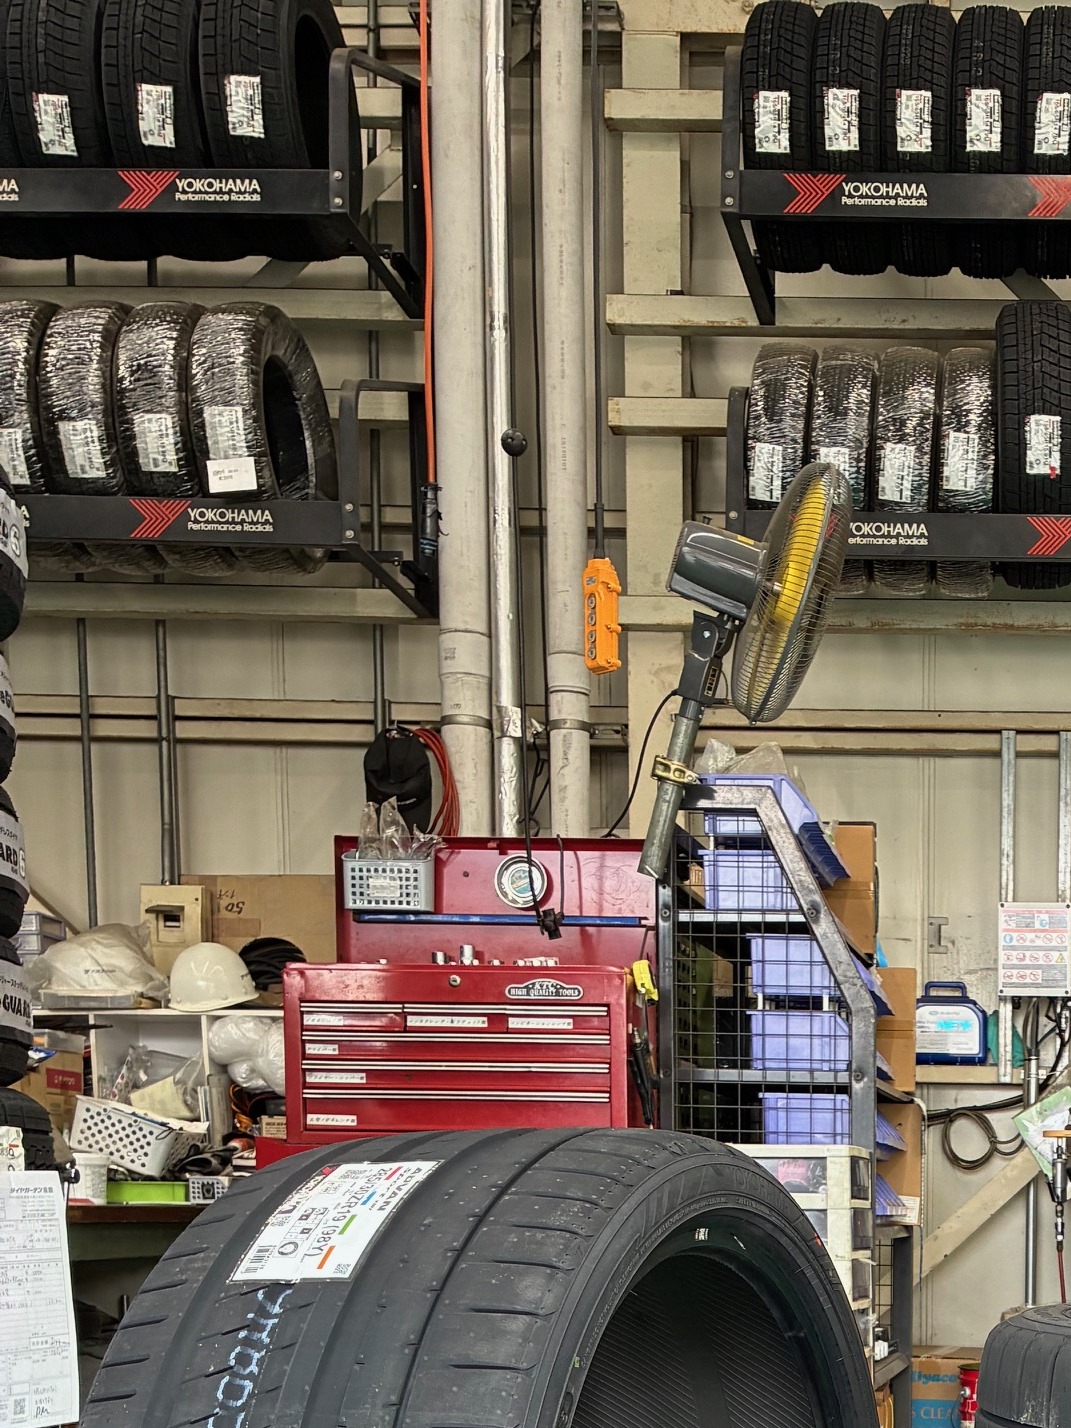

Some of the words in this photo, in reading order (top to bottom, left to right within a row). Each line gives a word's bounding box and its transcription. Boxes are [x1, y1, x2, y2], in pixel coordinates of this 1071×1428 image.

[176, 179, 260, 192] YOKOHAMA
[842, 182, 927, 196] YOKOHAMA
[175, 193, 228, 201] Performance
[231, 193, 261, 201] Radials
[842, 197, 895, 206] Performance
[897, 197, 927, 206] Radials
[188, 508, 273, 523] YOKOHAMA
[188, 523, 241, 531] Performance
[243, 523, 273, 531] Radials
[848, 537, 897, 545] erformance
[898, 537, 928, 545] Radials
[225, 901, 245, 915] 50
[534, 981, 556, 989] KTC
[510, 988, 527, 996] HIGH
[530, 988, 556, 997] QUALITY
[559, 988, 579, 997] TOOLS
[376, 1167, 422, 1212] ADVAN
[304, 1225, 340, 1258] (98Y)
